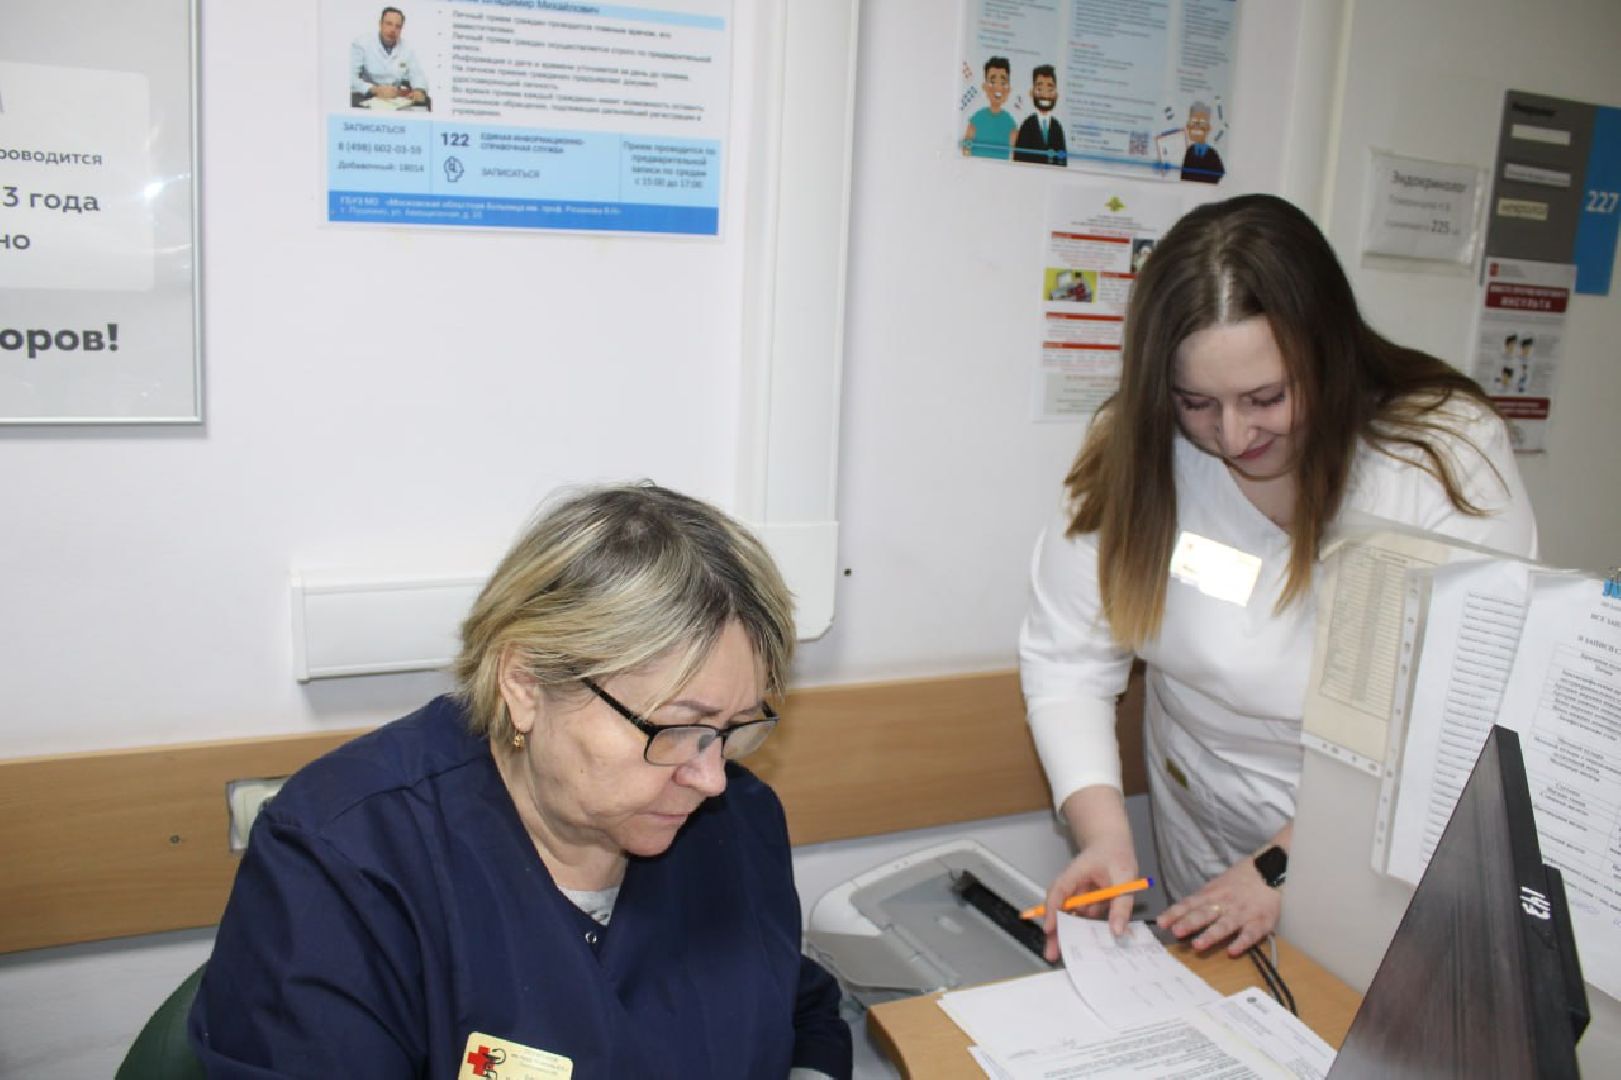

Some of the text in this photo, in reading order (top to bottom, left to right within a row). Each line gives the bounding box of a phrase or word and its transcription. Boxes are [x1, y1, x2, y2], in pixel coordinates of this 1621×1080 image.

[440, 132, 470, 147] 122
[30, 193, 101, 213] года
[1585, 189, 1619, 213] 227
[0, 323, 118, 359] оров!
